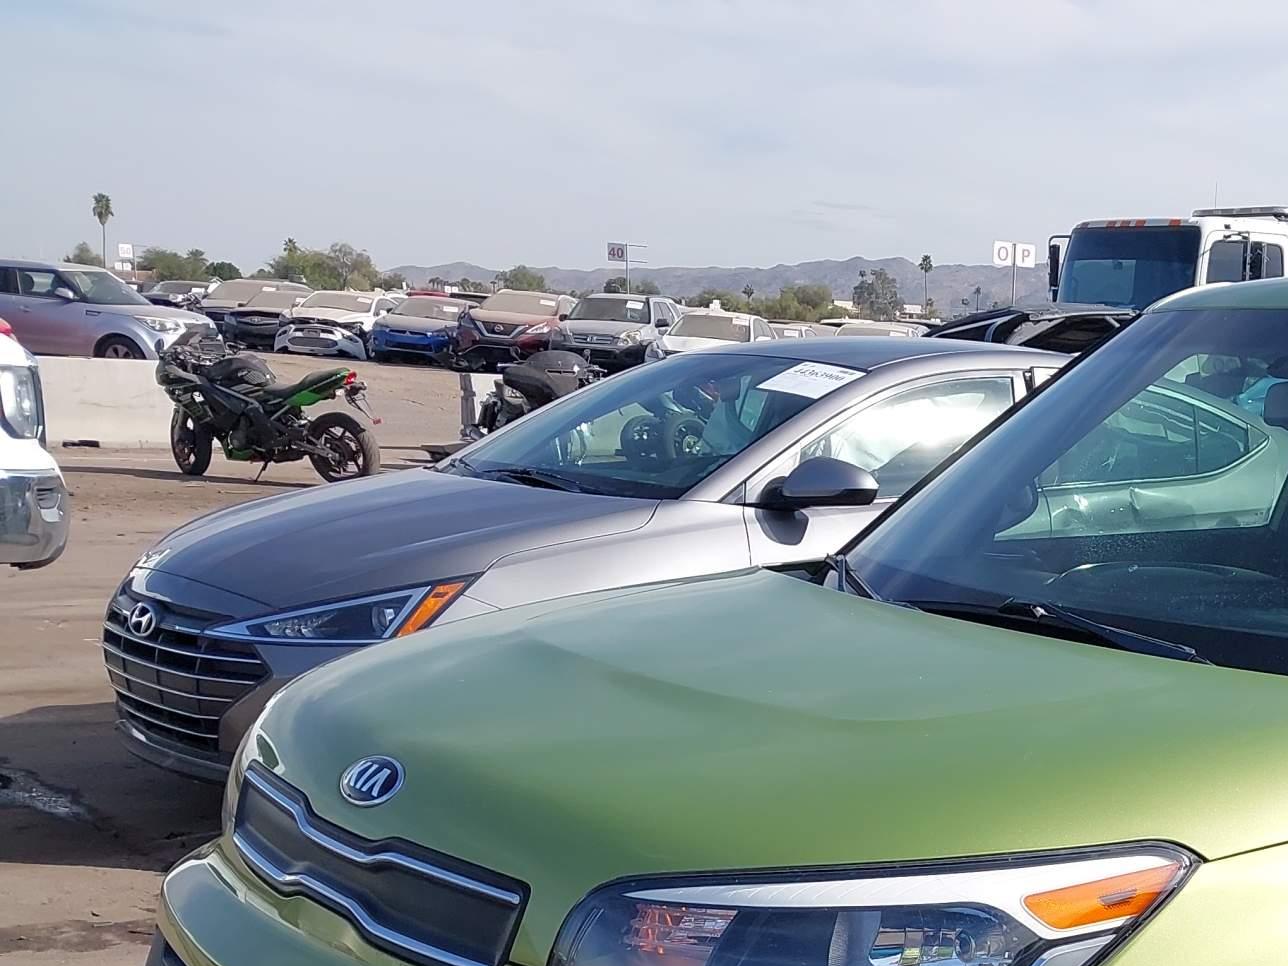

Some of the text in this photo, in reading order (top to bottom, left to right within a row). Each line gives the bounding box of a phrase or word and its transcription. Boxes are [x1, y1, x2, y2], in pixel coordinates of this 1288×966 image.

[608, 247, 624, 259] 40
[997, 246, 1009, 261] O
[1022, 248, 1031, 264] P
[344, 760, 392, 798] KIA
